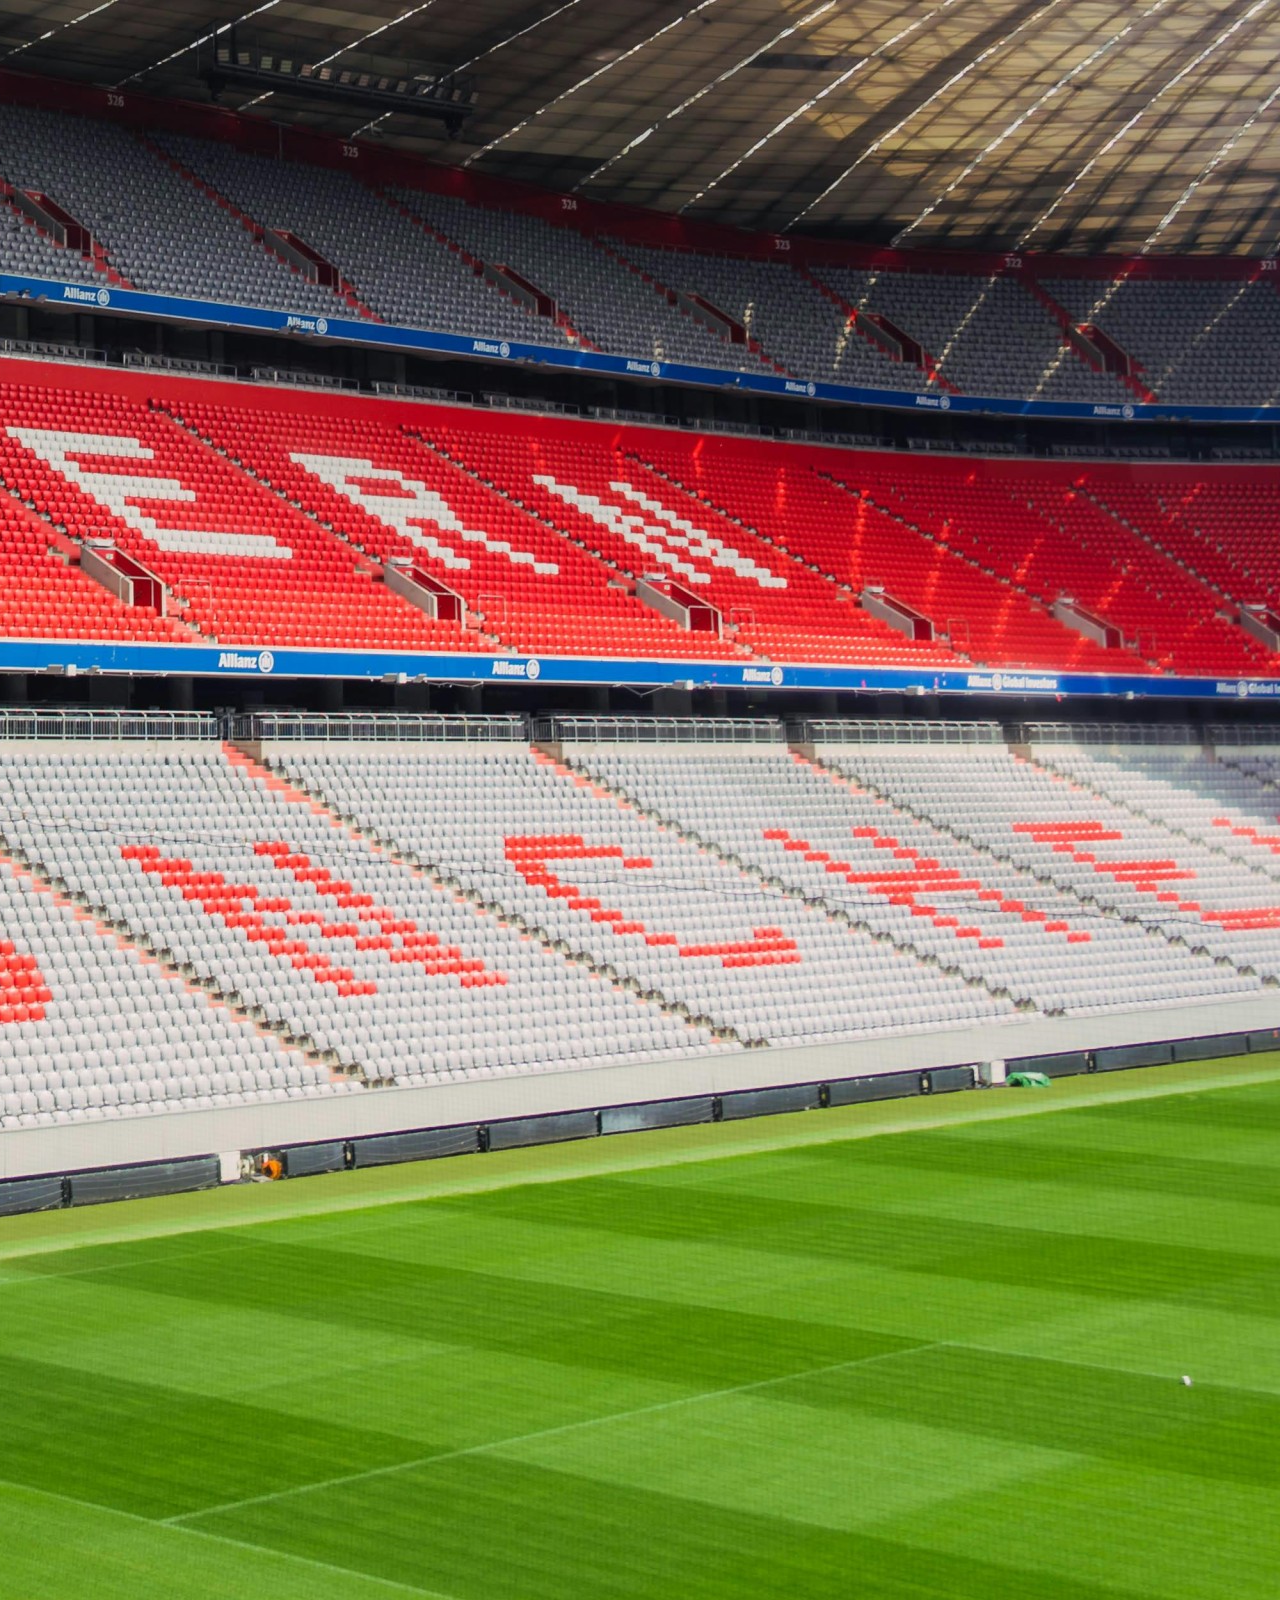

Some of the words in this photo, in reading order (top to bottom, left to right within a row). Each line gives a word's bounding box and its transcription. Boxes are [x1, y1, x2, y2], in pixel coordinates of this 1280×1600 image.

[107, 93, 125, 108] 326
[342, 145, 359, 158] 325
[63, 286, 96, 302] Allianz
[286, 315, 316, 331] Allianz
[473, 340, 499, 354] Allianz
[626, 360, 650, 373] Allianz
[785, 381, 807, 393] Allianz
[915, 395, 939, 407] Allianz
[1093, 405, 1121, 416] Allianz
[218, 653, 258, 669] Allianz
[491, 661, 526, 675] Allianz
[742, 668, 772, 682] Allianz
[967, 675, 993, 687] Allianz
[1003, 675, 1025, 688] Global
[1025, 677, 1058, 689] Investors
[1216, 682, 1237, 694] Allianz
